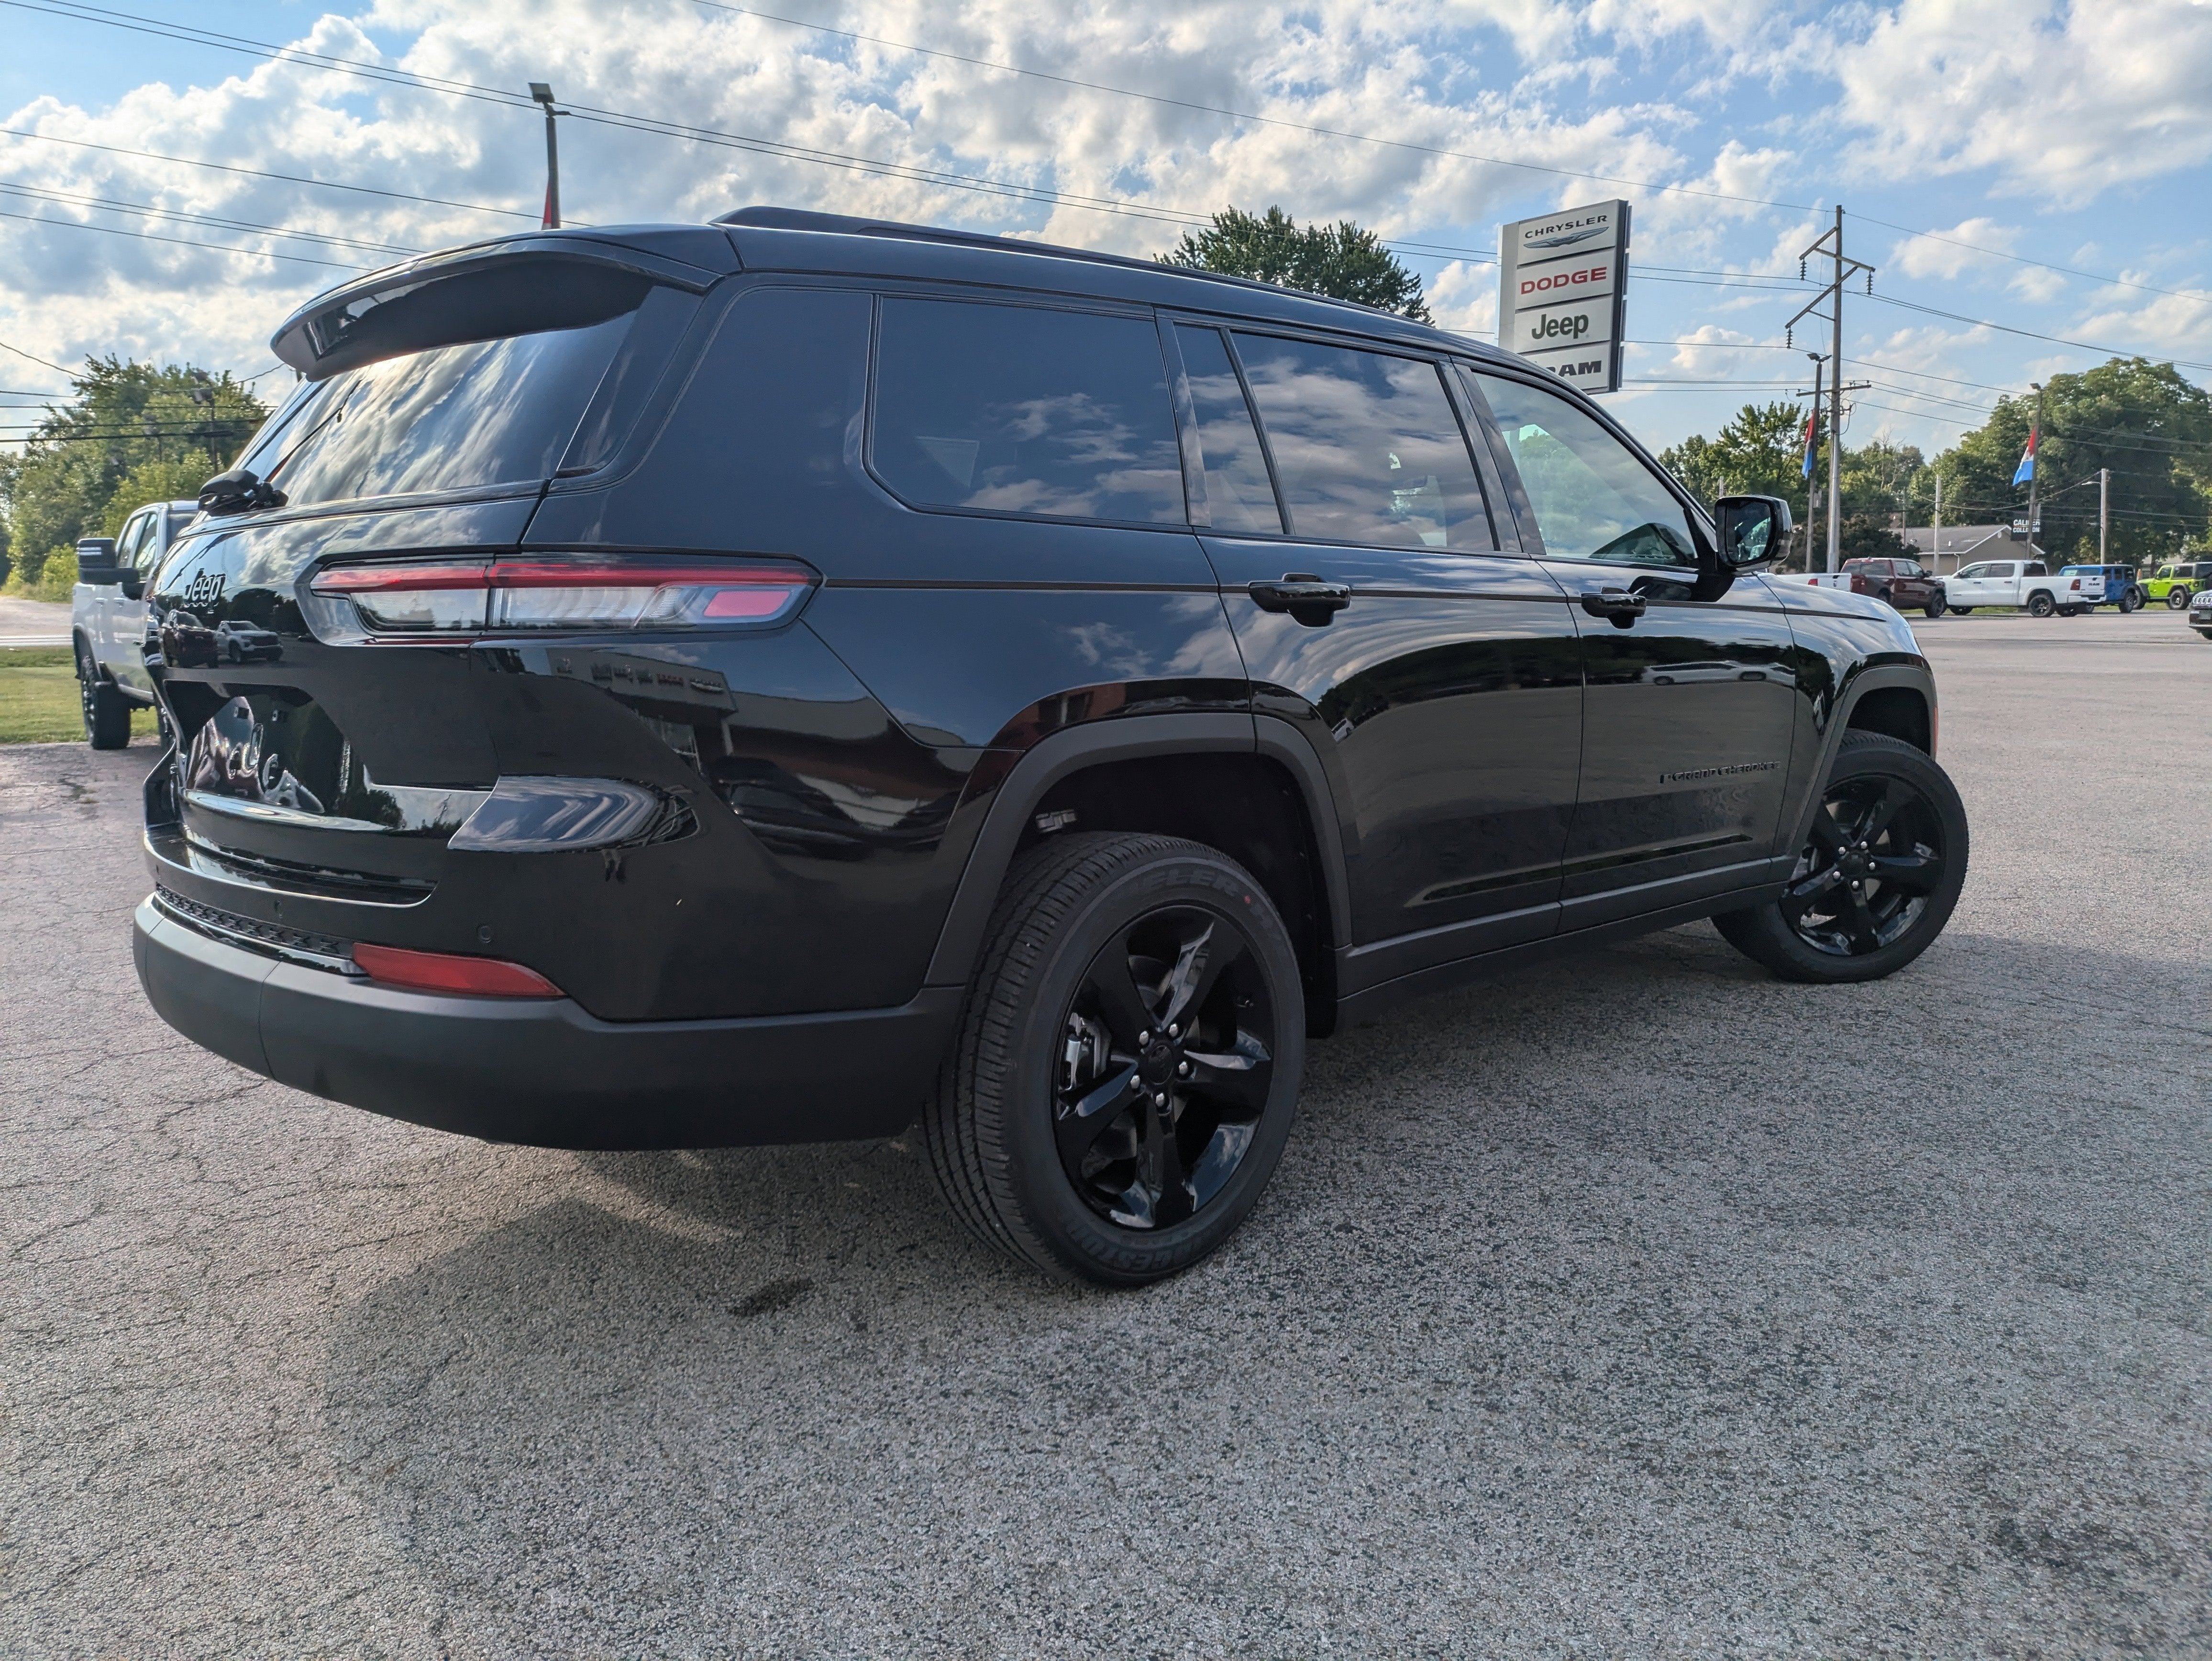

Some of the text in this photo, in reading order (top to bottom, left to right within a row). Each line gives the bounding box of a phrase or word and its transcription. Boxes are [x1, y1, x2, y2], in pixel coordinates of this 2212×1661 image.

[1525, 215, 1607, 239] CHRYSLER
[1521, 266, 1607, 295] DODGE
[1531, 314, 1589, 340] Jeep
[182, 568, 226, 602] Jeep
